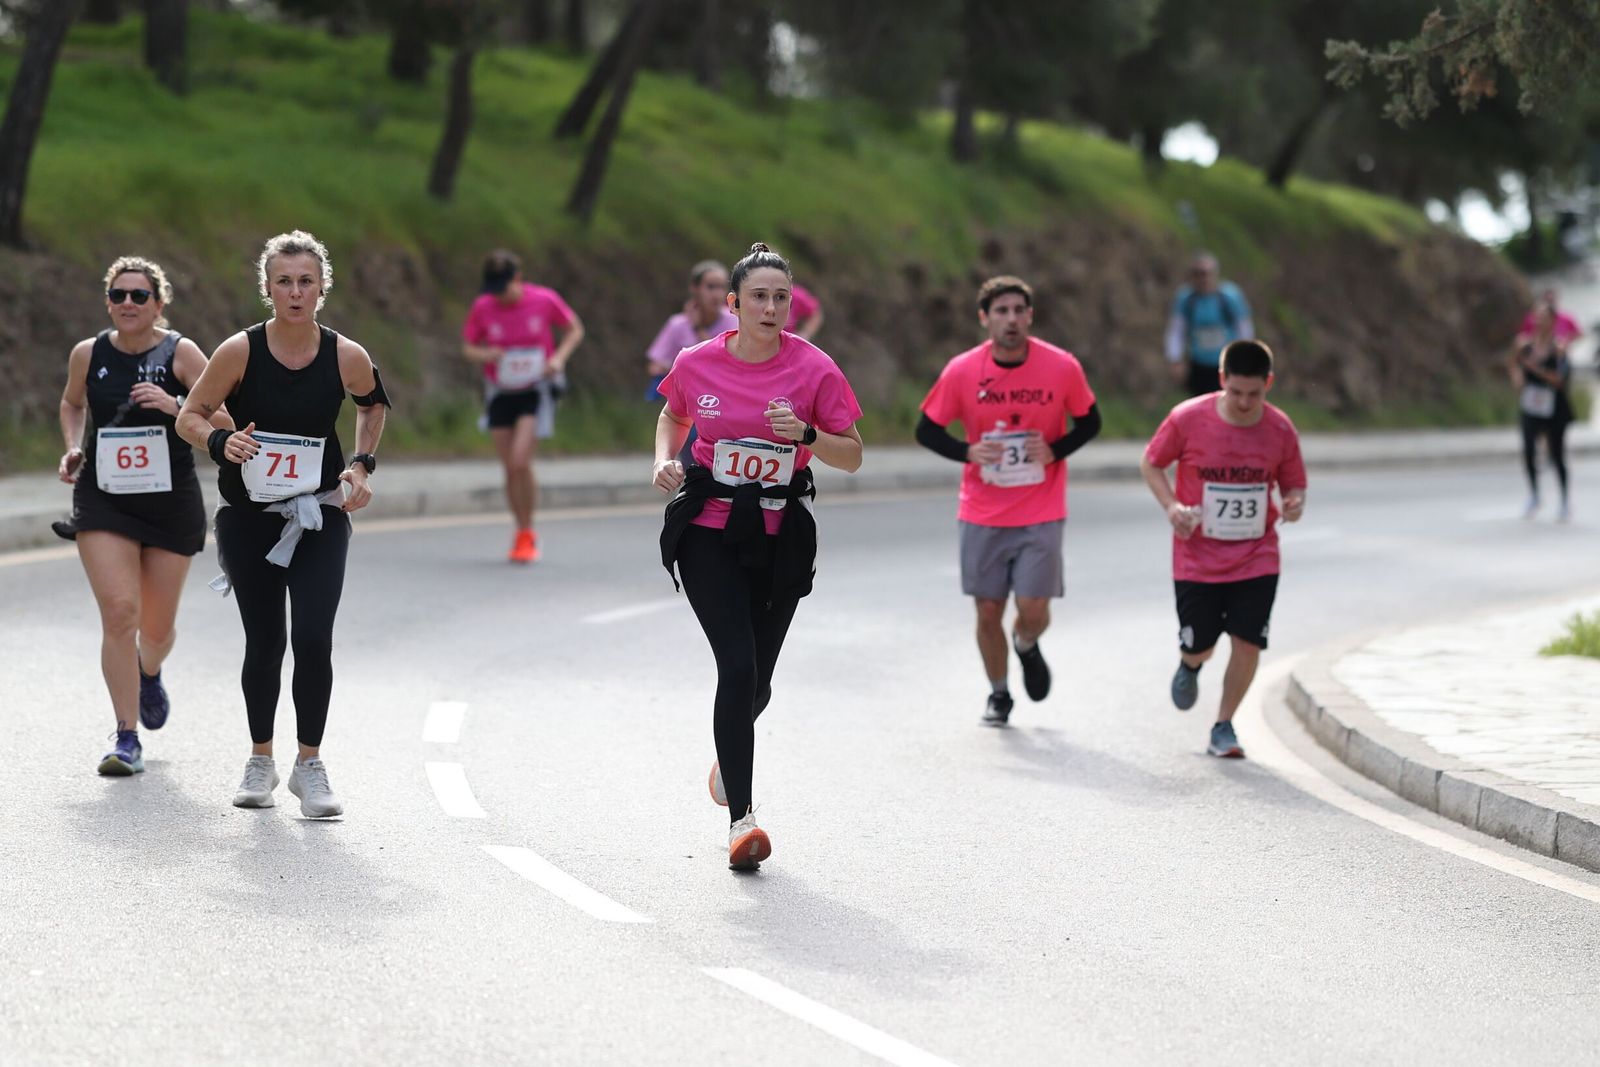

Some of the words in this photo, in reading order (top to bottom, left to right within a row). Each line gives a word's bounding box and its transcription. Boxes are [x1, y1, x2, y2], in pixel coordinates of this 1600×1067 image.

[697, 409, 721, 417] HYUNDAI
[116, 445, 149, 470] 63
[265, 452, 299, 479] 71
[725, 451, 781, 484] 102
[1215, 498, 1258, 519] 733
